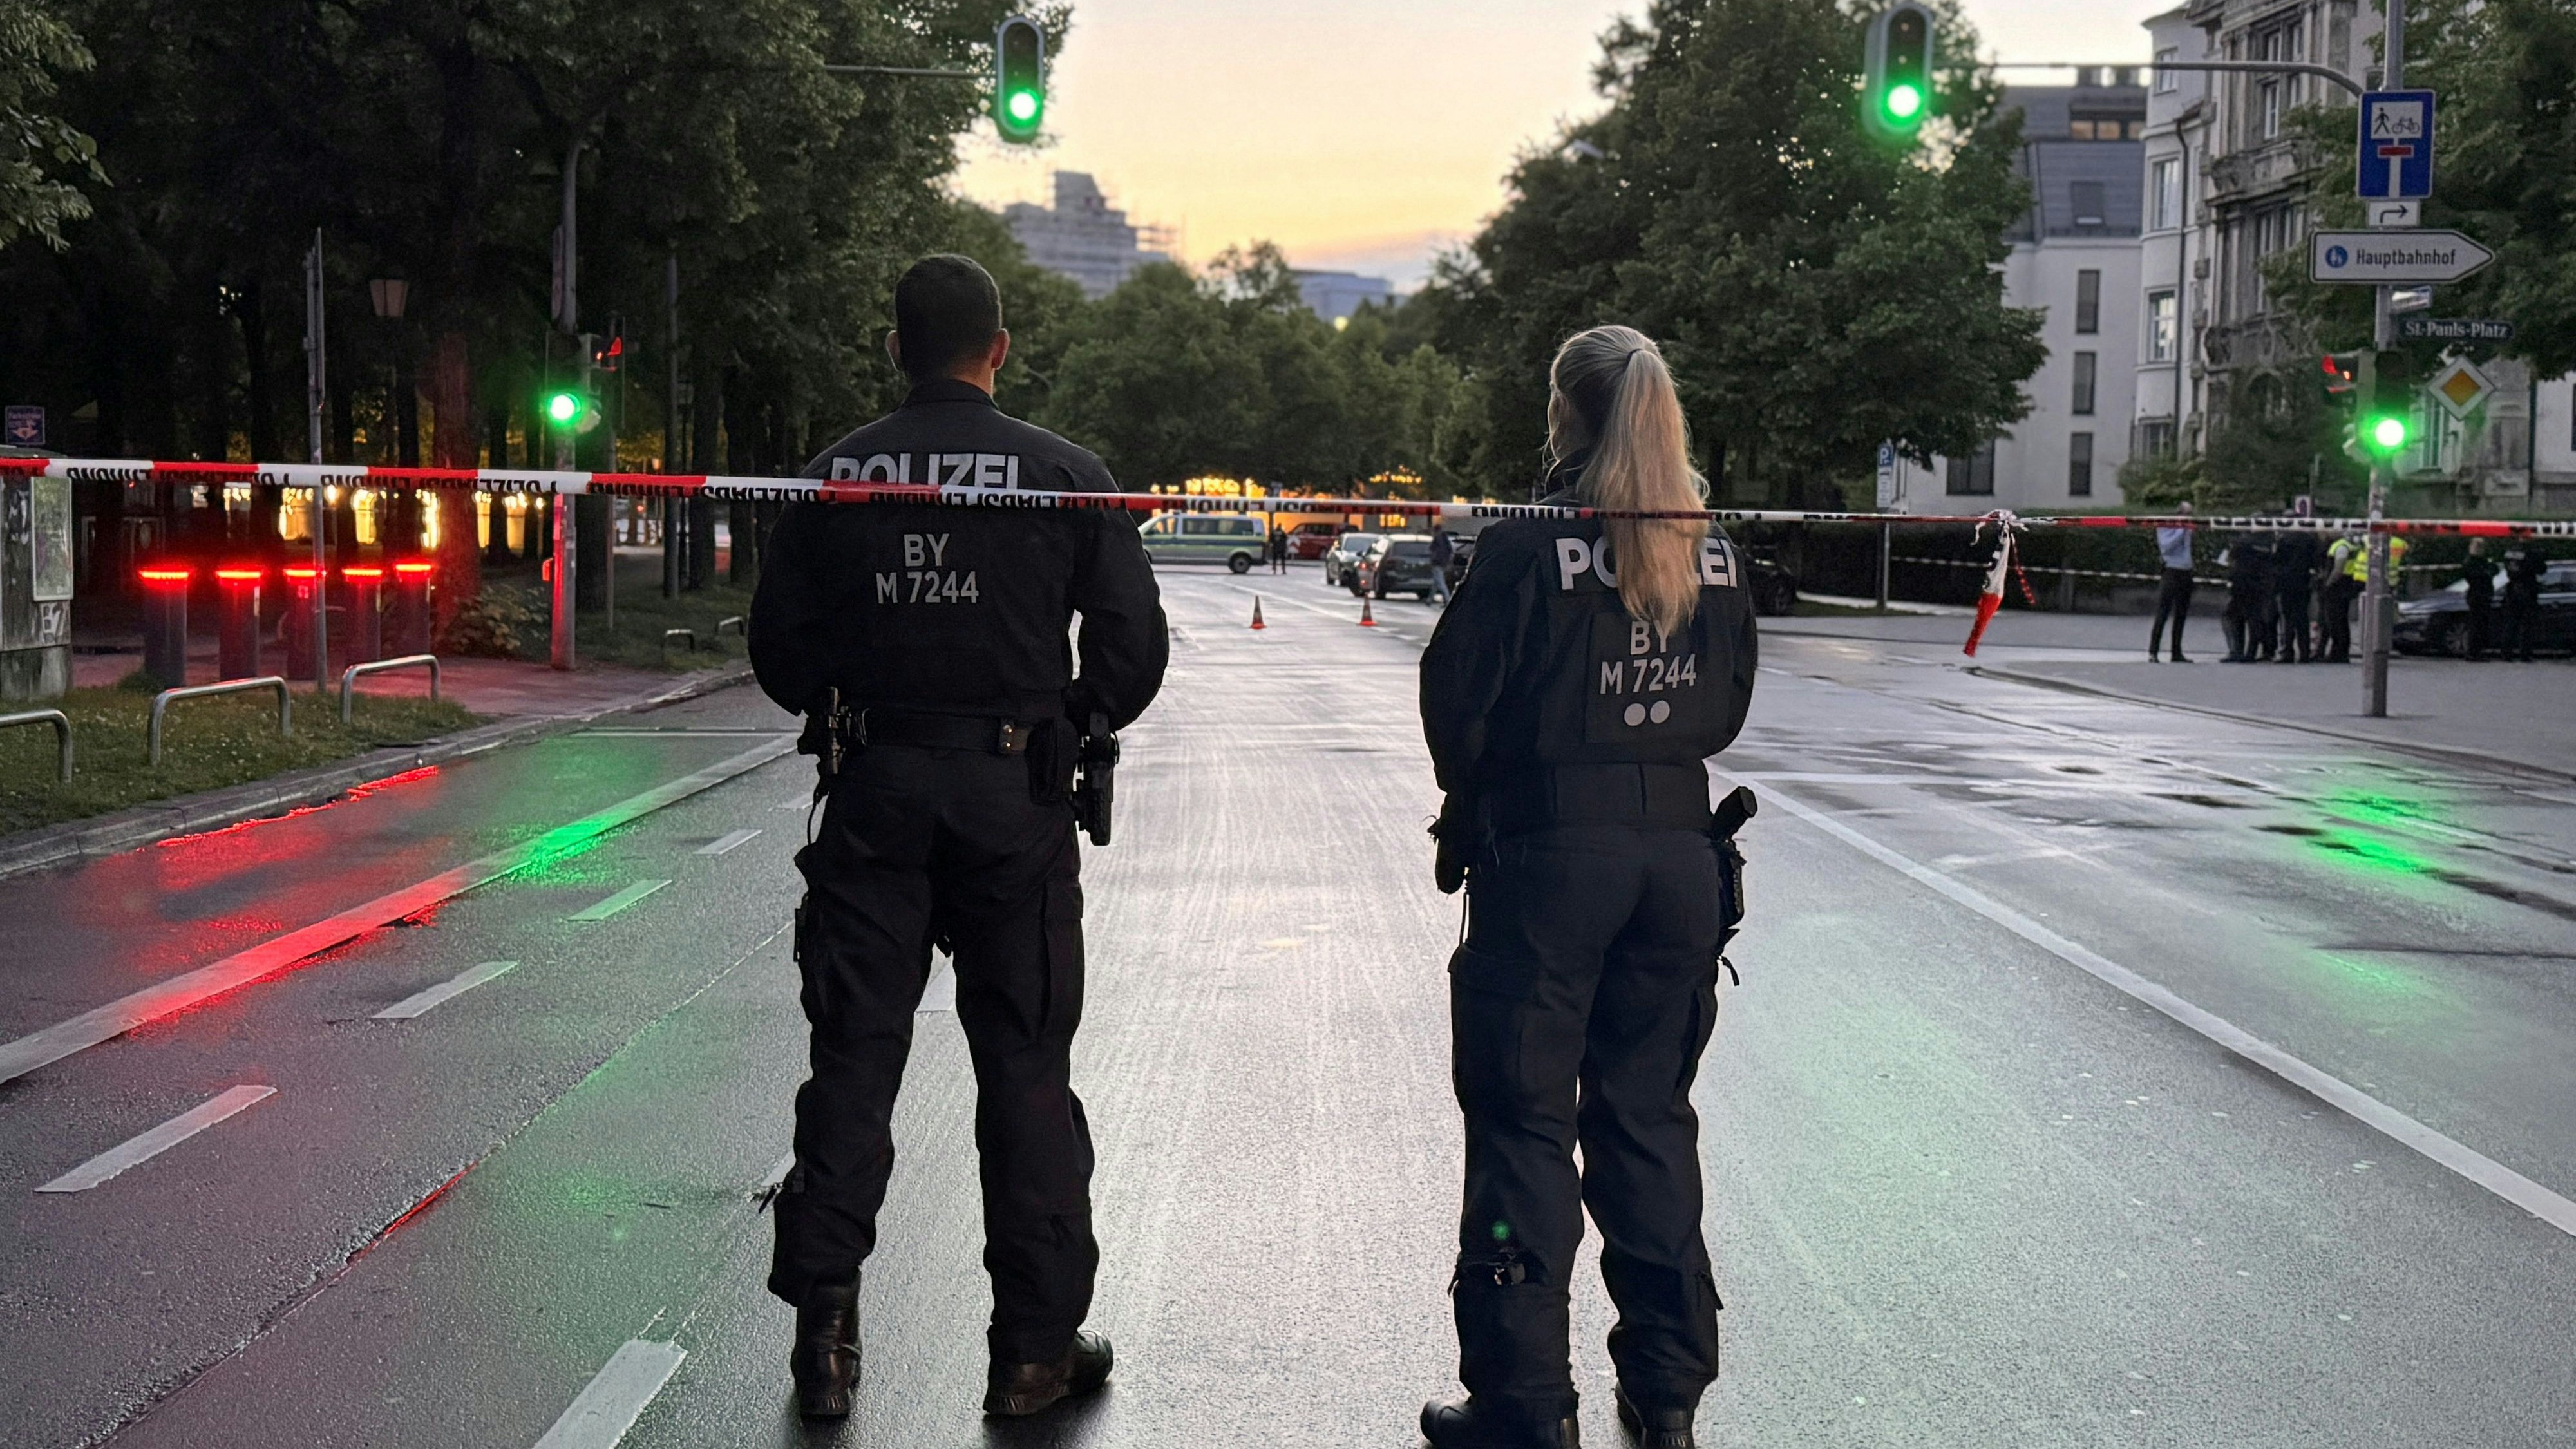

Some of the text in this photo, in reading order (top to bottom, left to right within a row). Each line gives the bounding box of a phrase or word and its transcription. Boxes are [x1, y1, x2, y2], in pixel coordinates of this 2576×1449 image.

[2356, 249, 2456, 269] Hauptbahnhof
[2406, 321, 2507, 338] St.-Pauls-Platz
[904, 534, 949, 567] BY
[1556, 536, 1737, 590] POEI
[876, 571, 979, 603] M 7244
[1631, 620, 1669, 655] BY
[1600, 654, 1696, 694] M 7244
